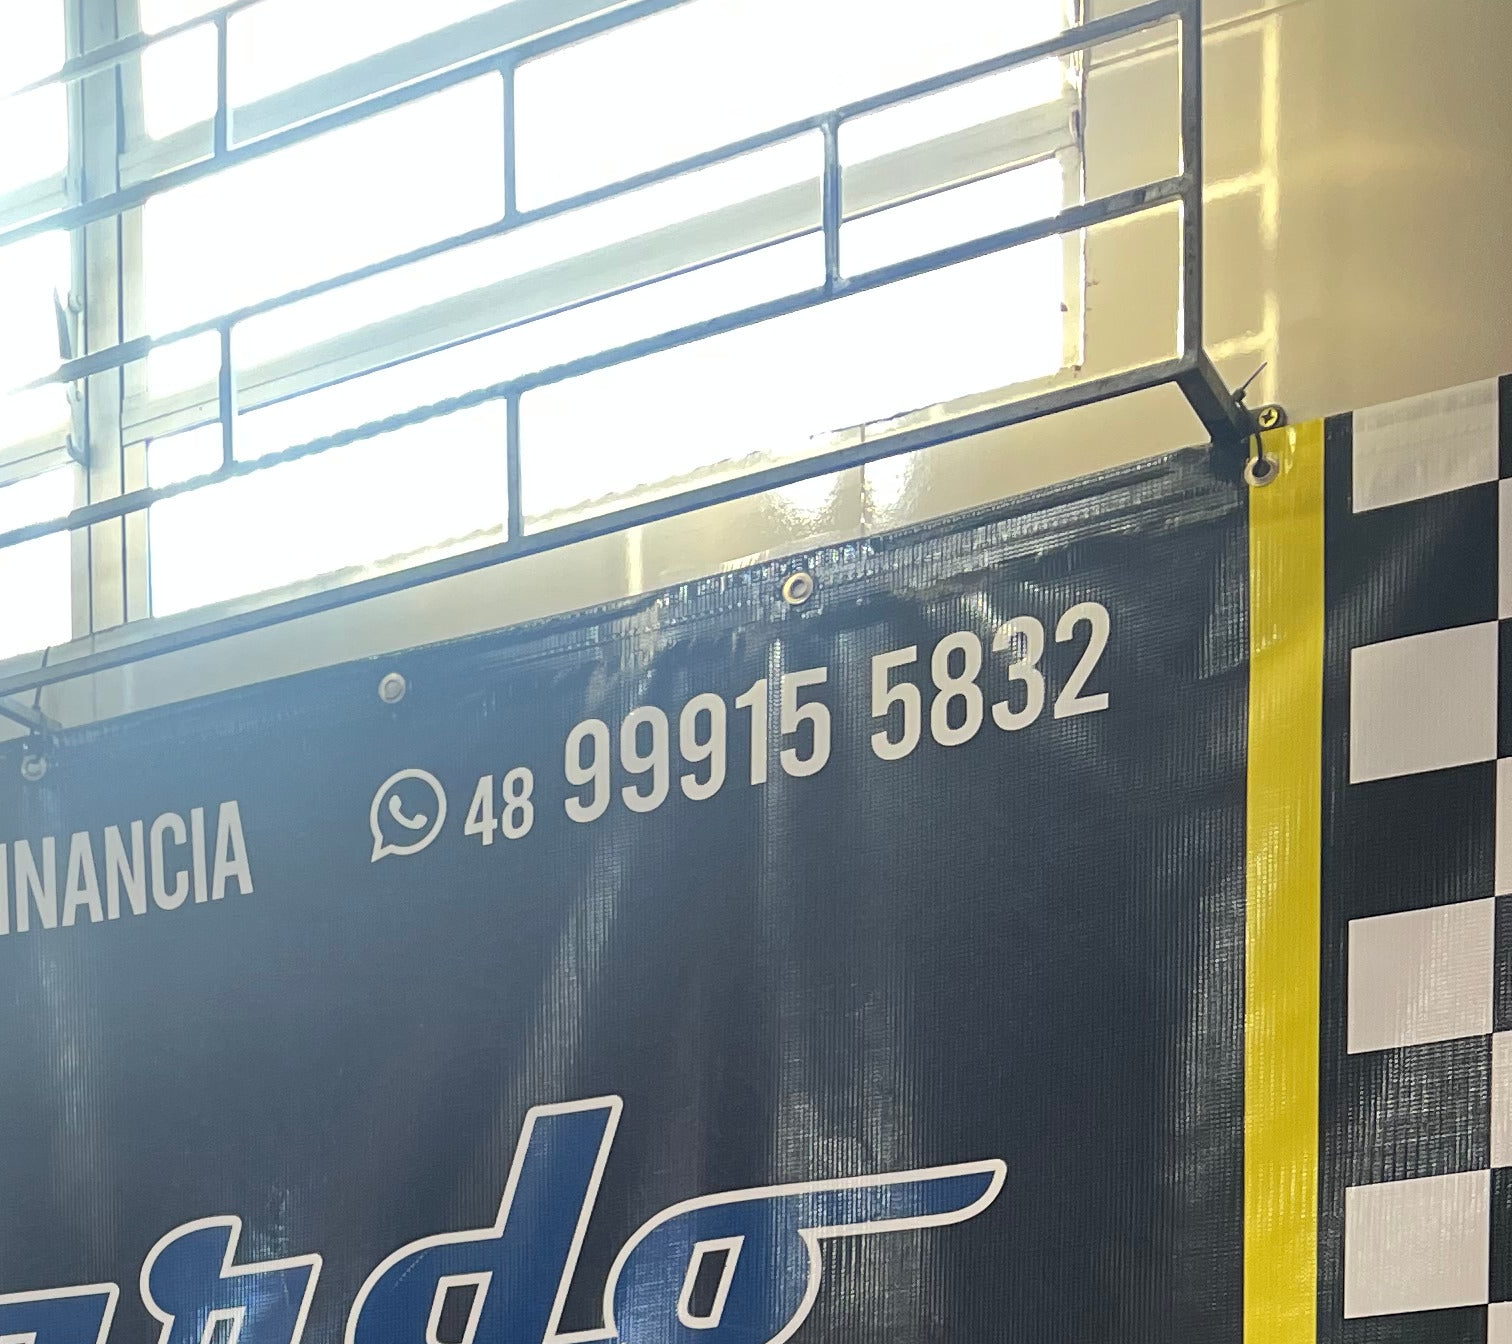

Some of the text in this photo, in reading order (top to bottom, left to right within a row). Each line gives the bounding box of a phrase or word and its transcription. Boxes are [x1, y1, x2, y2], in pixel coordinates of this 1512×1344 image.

[463, 601, 1112, 846] 48 99915 5832
